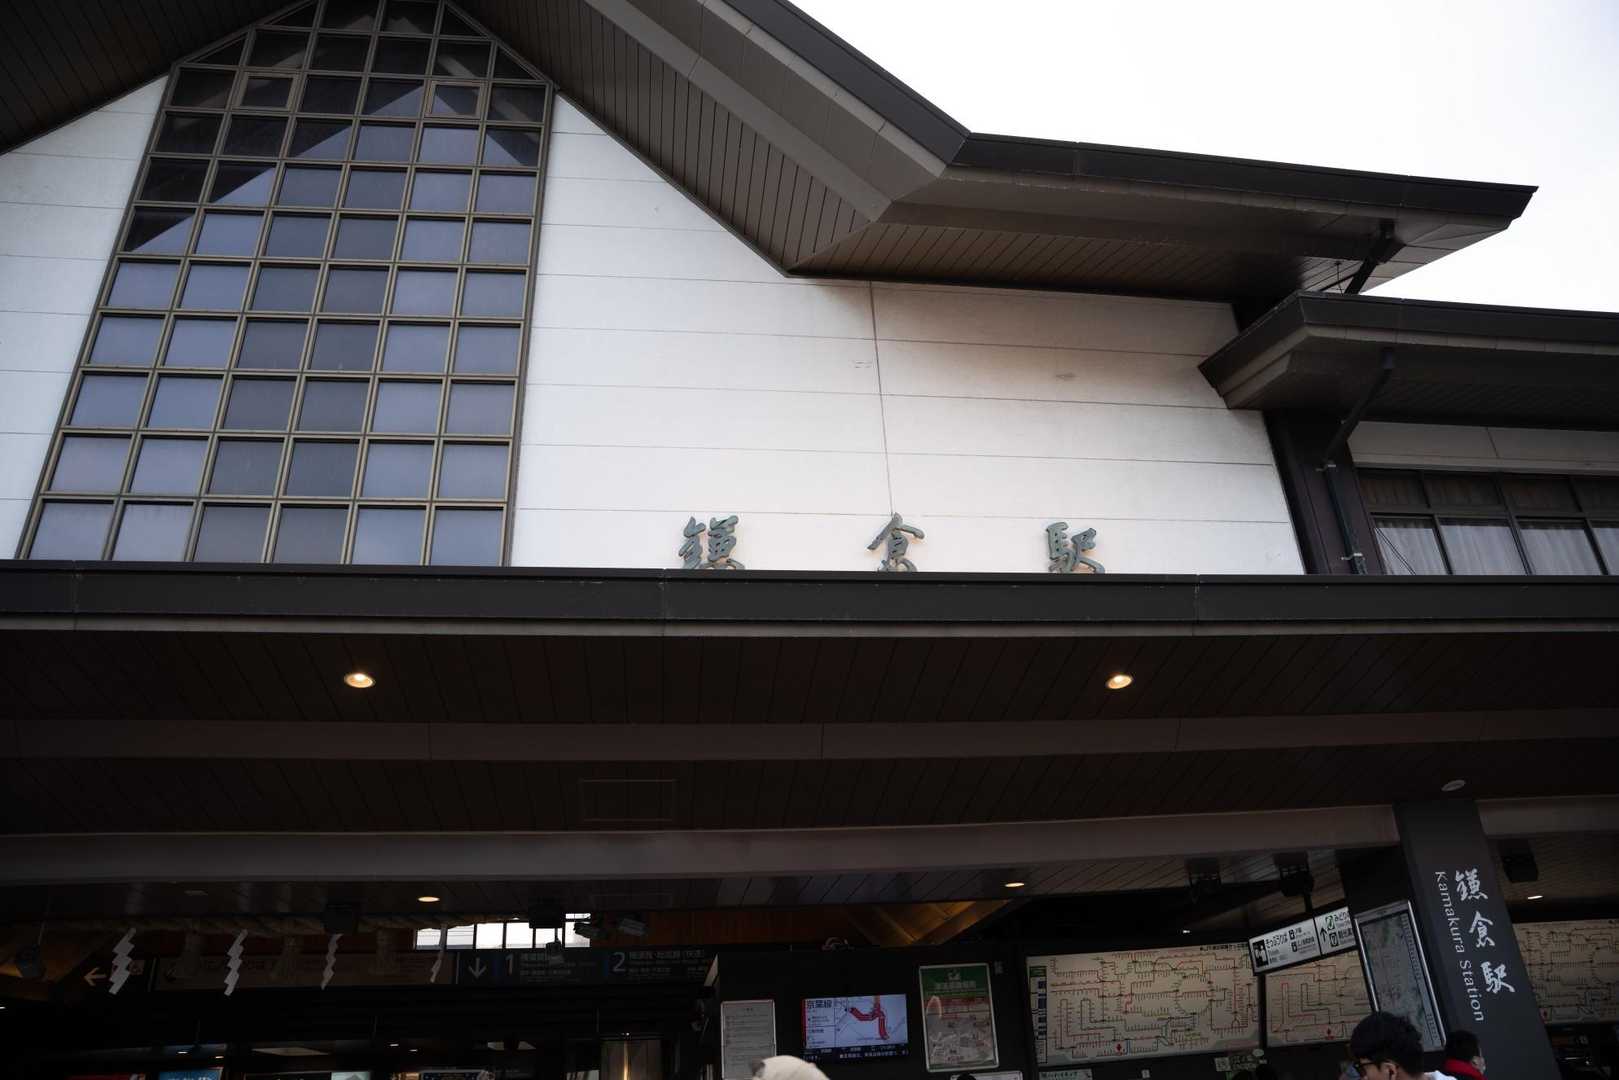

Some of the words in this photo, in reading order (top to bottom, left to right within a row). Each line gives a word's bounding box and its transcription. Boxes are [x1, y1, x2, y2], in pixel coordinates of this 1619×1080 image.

[1435, 871, 1465, 953] Kamakura
[1459, 960, 1485, 1021] Station
[504, 953, 513, 976] 1
[610, 952, 626, 974] 2
